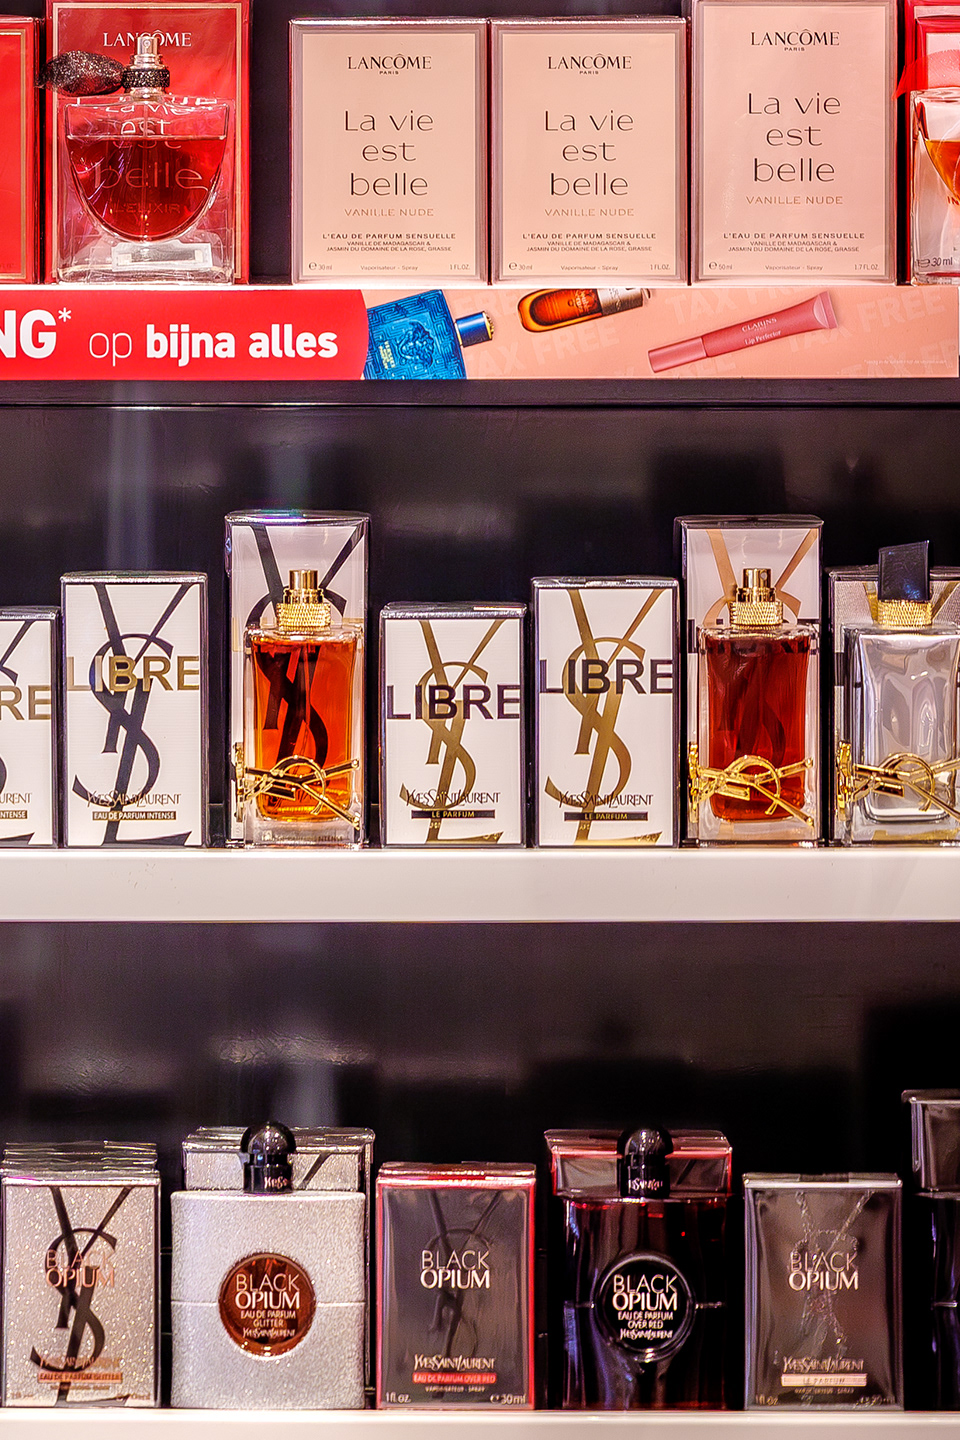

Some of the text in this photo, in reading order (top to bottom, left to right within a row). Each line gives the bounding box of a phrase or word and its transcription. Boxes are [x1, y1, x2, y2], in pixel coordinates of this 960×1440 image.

[751, 29, 840, 46] LANCÔME
[347, 53, 432, 70] LANCÔME
[547, 53, 632, 70] LANCÔME
[748, 92, 841, 115] La vie
[344, 109, 434, 132] La vie
[544, 109, 634, 132] La vie
[766, 126, 823, 147] est
[361, 142, 417, 162] est
[562, 142, 617, 162] est
[754, 158, 834, 183] belle
[350, 172, 429, 197] belle
[550, 172, 628, 197] belle
[746, 196, 843, 205] VANILLE NUDE
[344, 209, 434, 217] VANILLE NUDE
[741, 318, 776, 332] CLARINS
[89, 333, 131, 366] op
[146, 323, 235, 366] bijna
[248, 323, 338, 359] alles
[744, 328, 781, 348] Lip Perfector
[67, 655, 199, 691] LIBRE
[540, 659, 673, 694] LIBRE
[386, 684, 520, 719] LIBRE
[431, 810, 475, 818] LE PARFUM
[422, 1250, 490, 1270] BLACK
[236, 1274, 299, 1292] BLACK
[420, 1270, 490, 1289] OPIUM
[613, 1275, 677, 1293] BLACK
[788, 1272, 858, 1291] OPIUM
[235, 1291, 300, 1309] OPIUM
[612, 1292, 677, 1311] OPIUM
